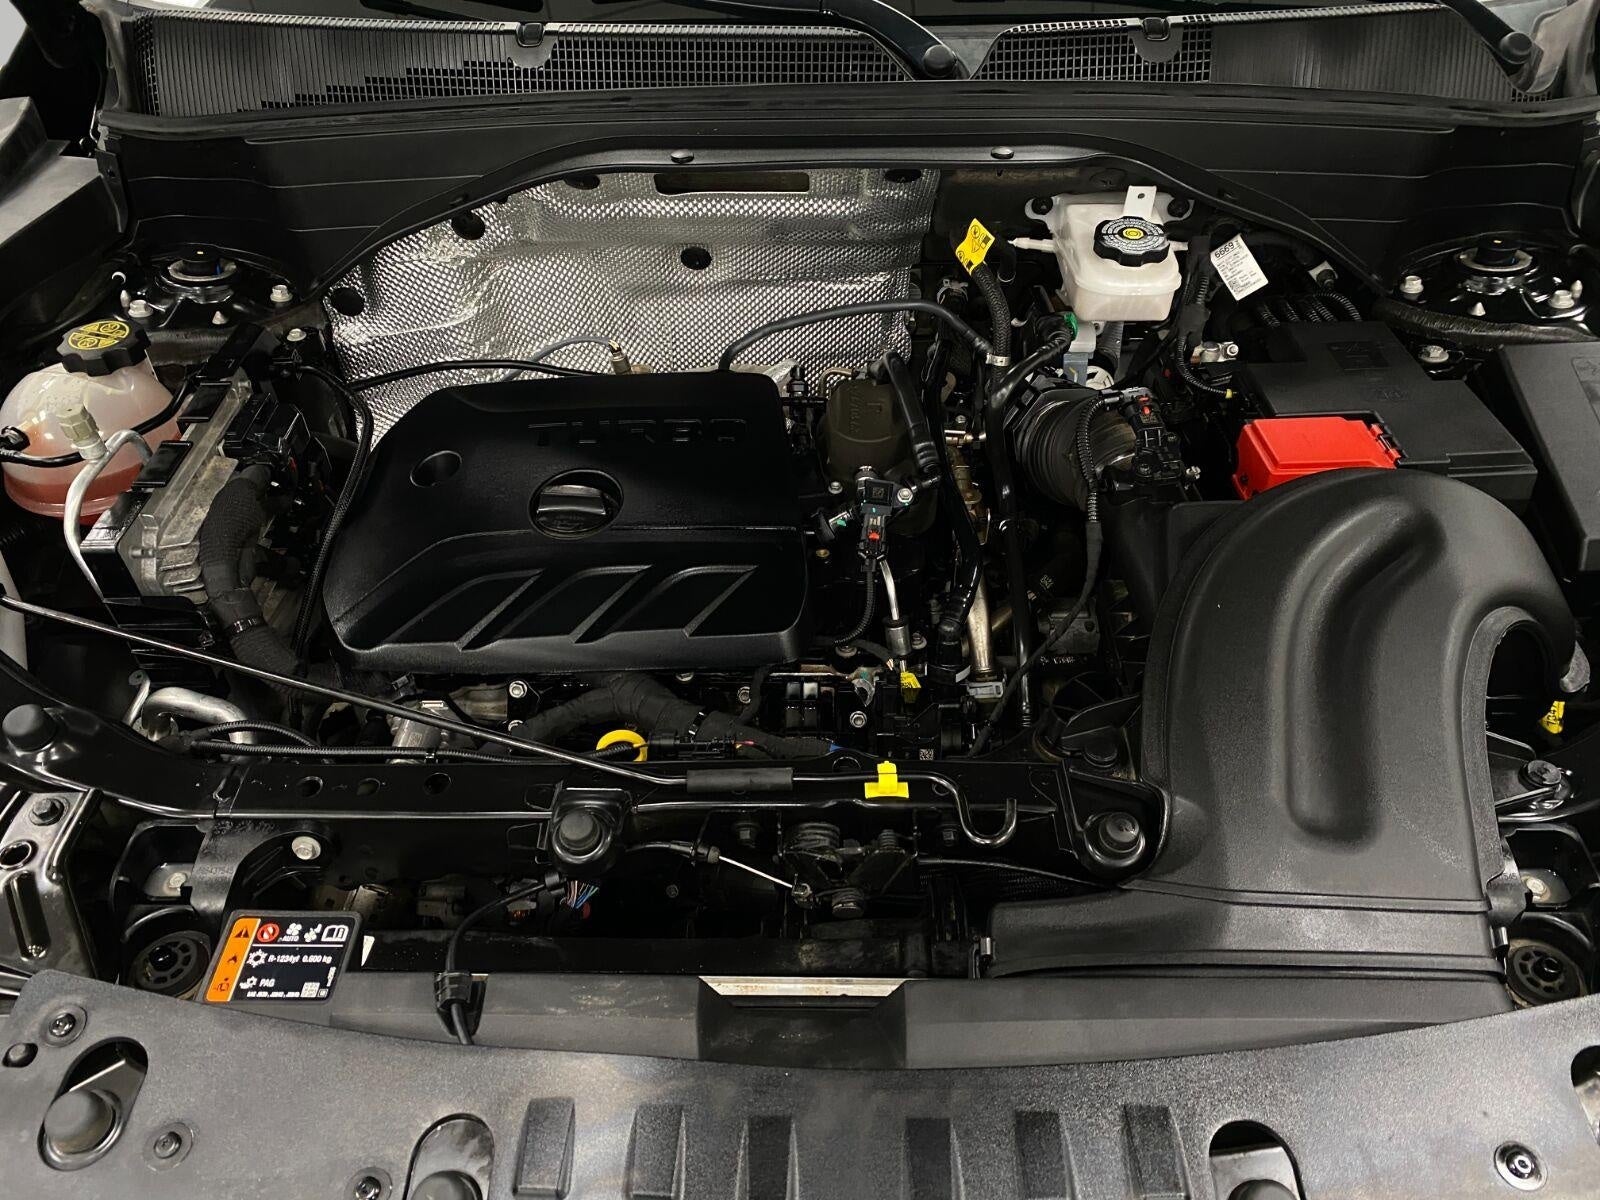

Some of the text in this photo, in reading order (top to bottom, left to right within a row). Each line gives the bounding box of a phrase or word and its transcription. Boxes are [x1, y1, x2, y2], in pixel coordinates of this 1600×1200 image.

[1214, 241, 1235, 258] 6669
[528, 419, 747, 446] TURBO
[267, 954, 300, 964] R-1234yf
[322, 954, 333, 965] kg
[259, 978, 276, 987] PAG
